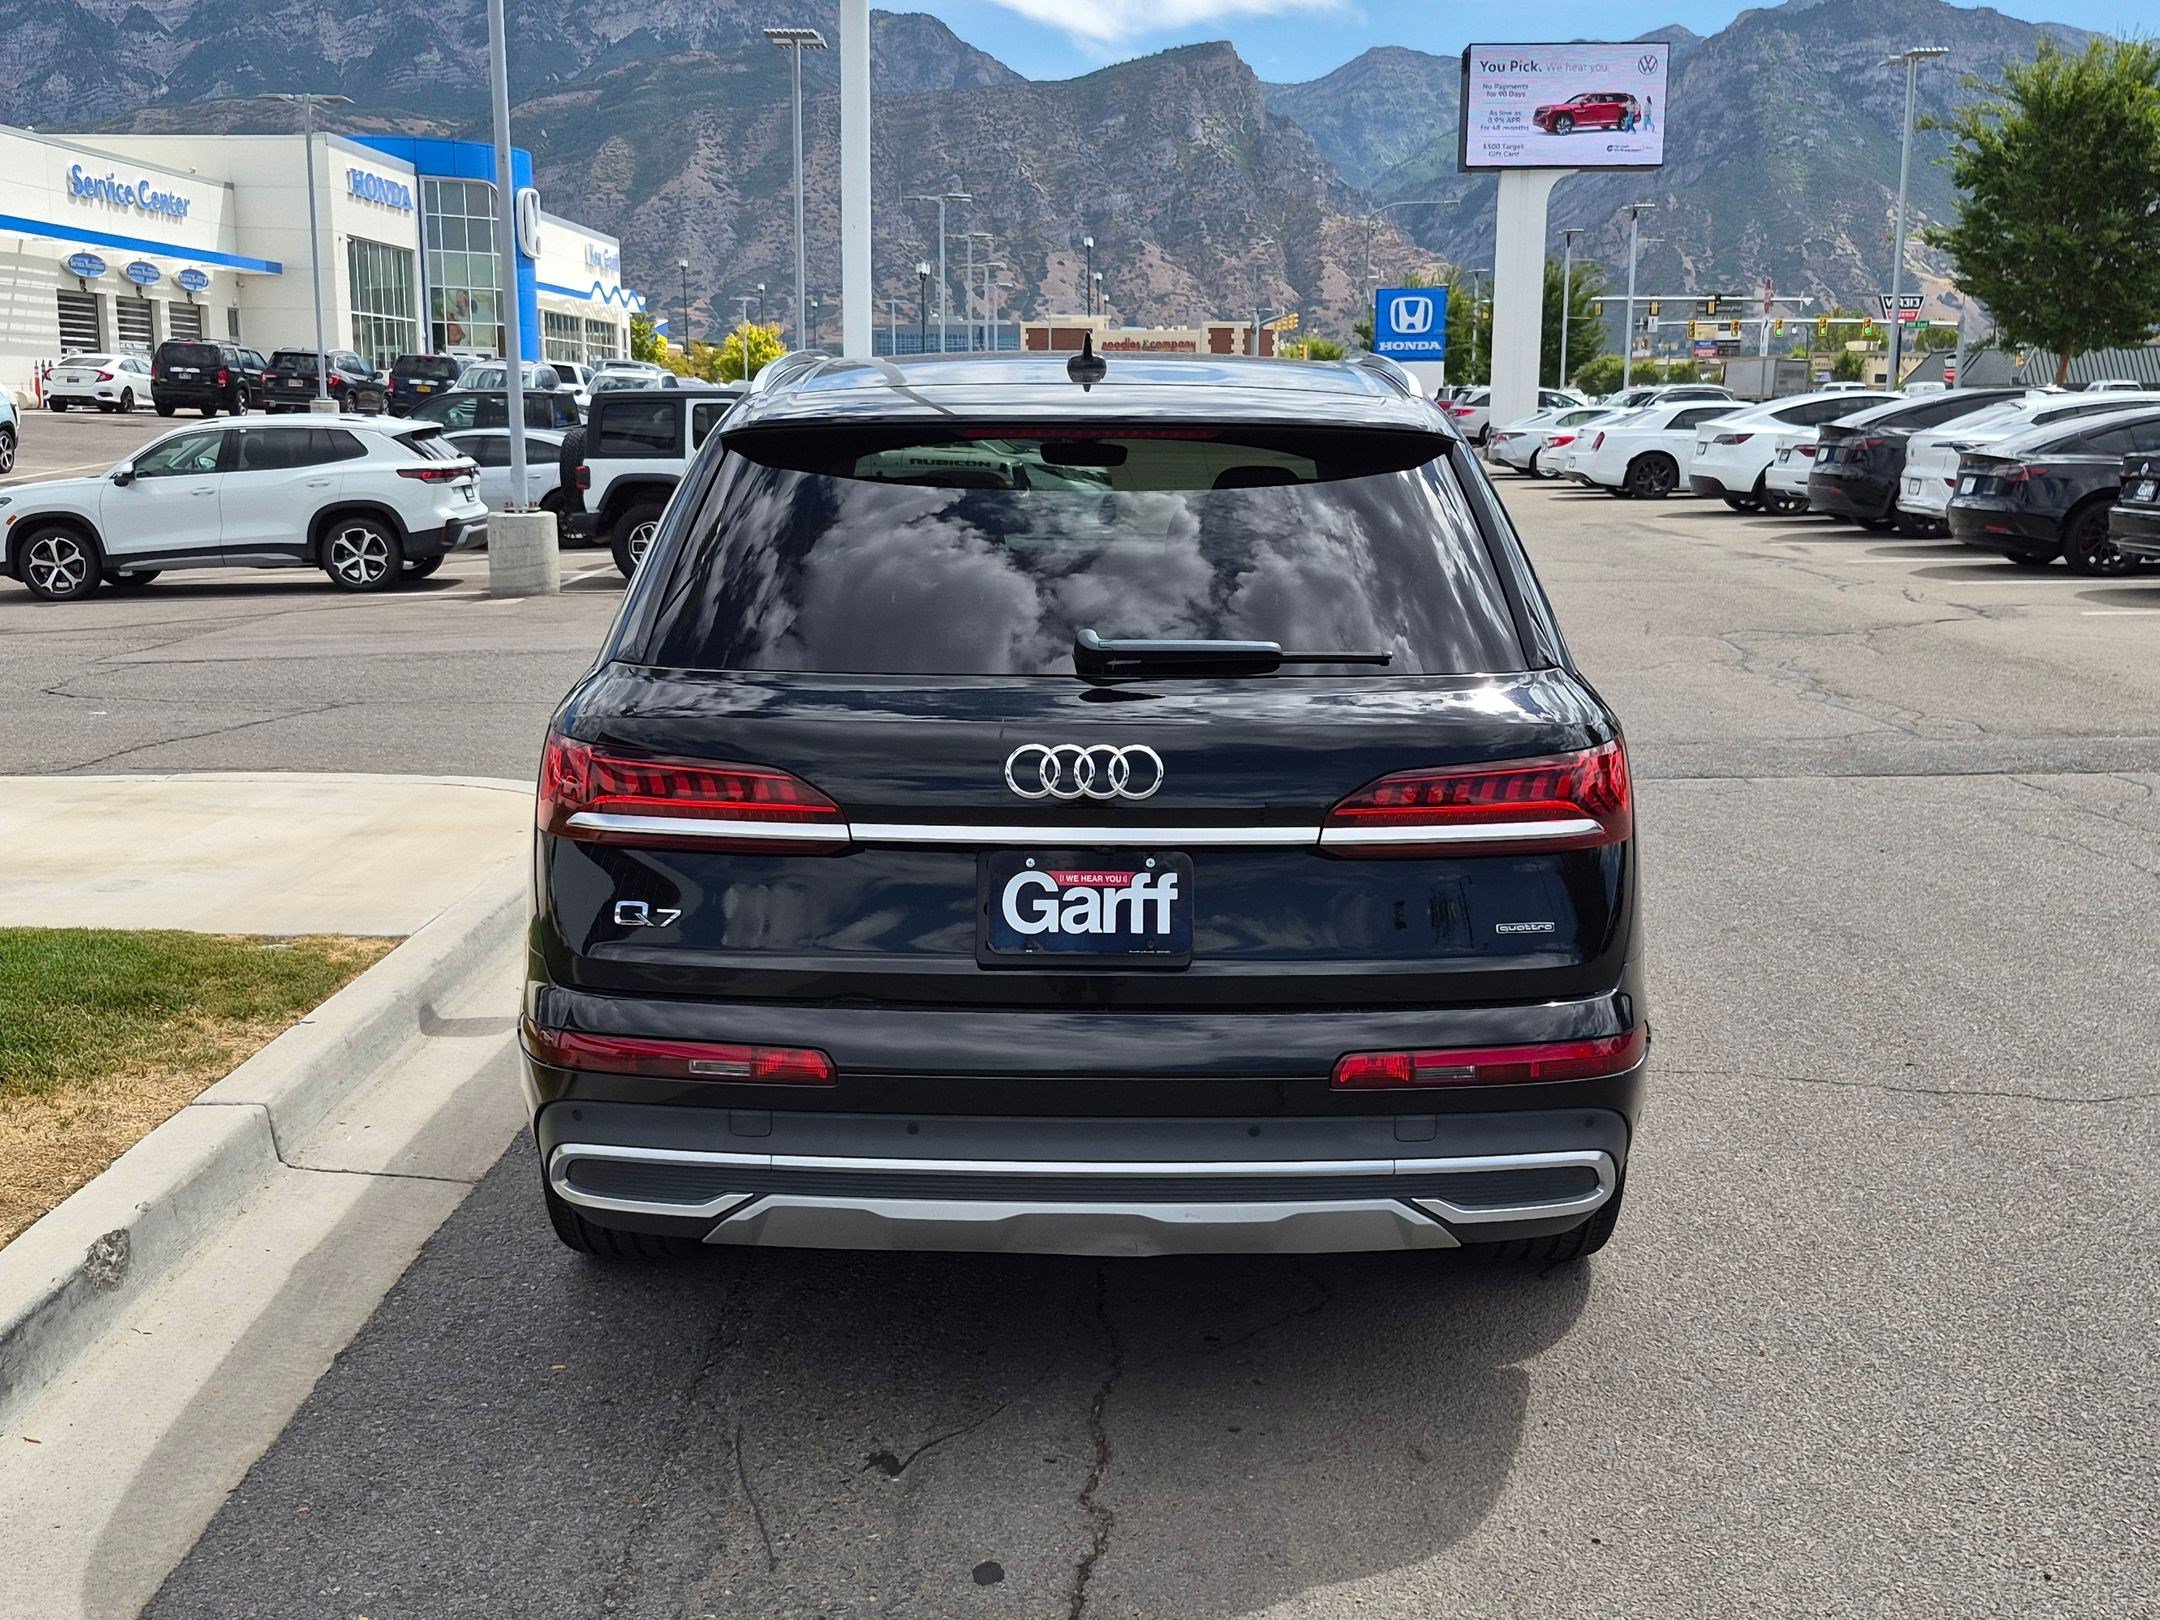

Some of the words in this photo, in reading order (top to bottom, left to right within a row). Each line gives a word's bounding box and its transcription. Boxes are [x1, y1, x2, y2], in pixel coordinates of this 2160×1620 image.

[1480, 60, 1506, 73] You
[1510, 60, 1542, 73] Pick.
[1546, 63, 1562, 73] We
[1565, 63, 1587, 73] hear
[1494, 83, 1529, 92] Payments
[1509, 91, 1526, 99] Days
[1502, 143, 1525, 152] Target
[70, 163, 134, 206] Service
[138, 180, 190, 217] Center
[349, 168, 414, 210] HONDA
[1101, 337, 1140, 351] noodles
[1150, 340, 1196, 352] company
[1378, 341, 1442, 352] HONDA
[909, 457, 991, 468] RUBICON
[1065, 875, 1079, 883] WE
[1080, 875, 1103, 883] HEAR
[1104, 875, 1122, 883] YOU
[1002, 870, 1178, 935] Garff
[614, 900, 682, 927] Q7
[1499, 923, 1553, 932] quattro
